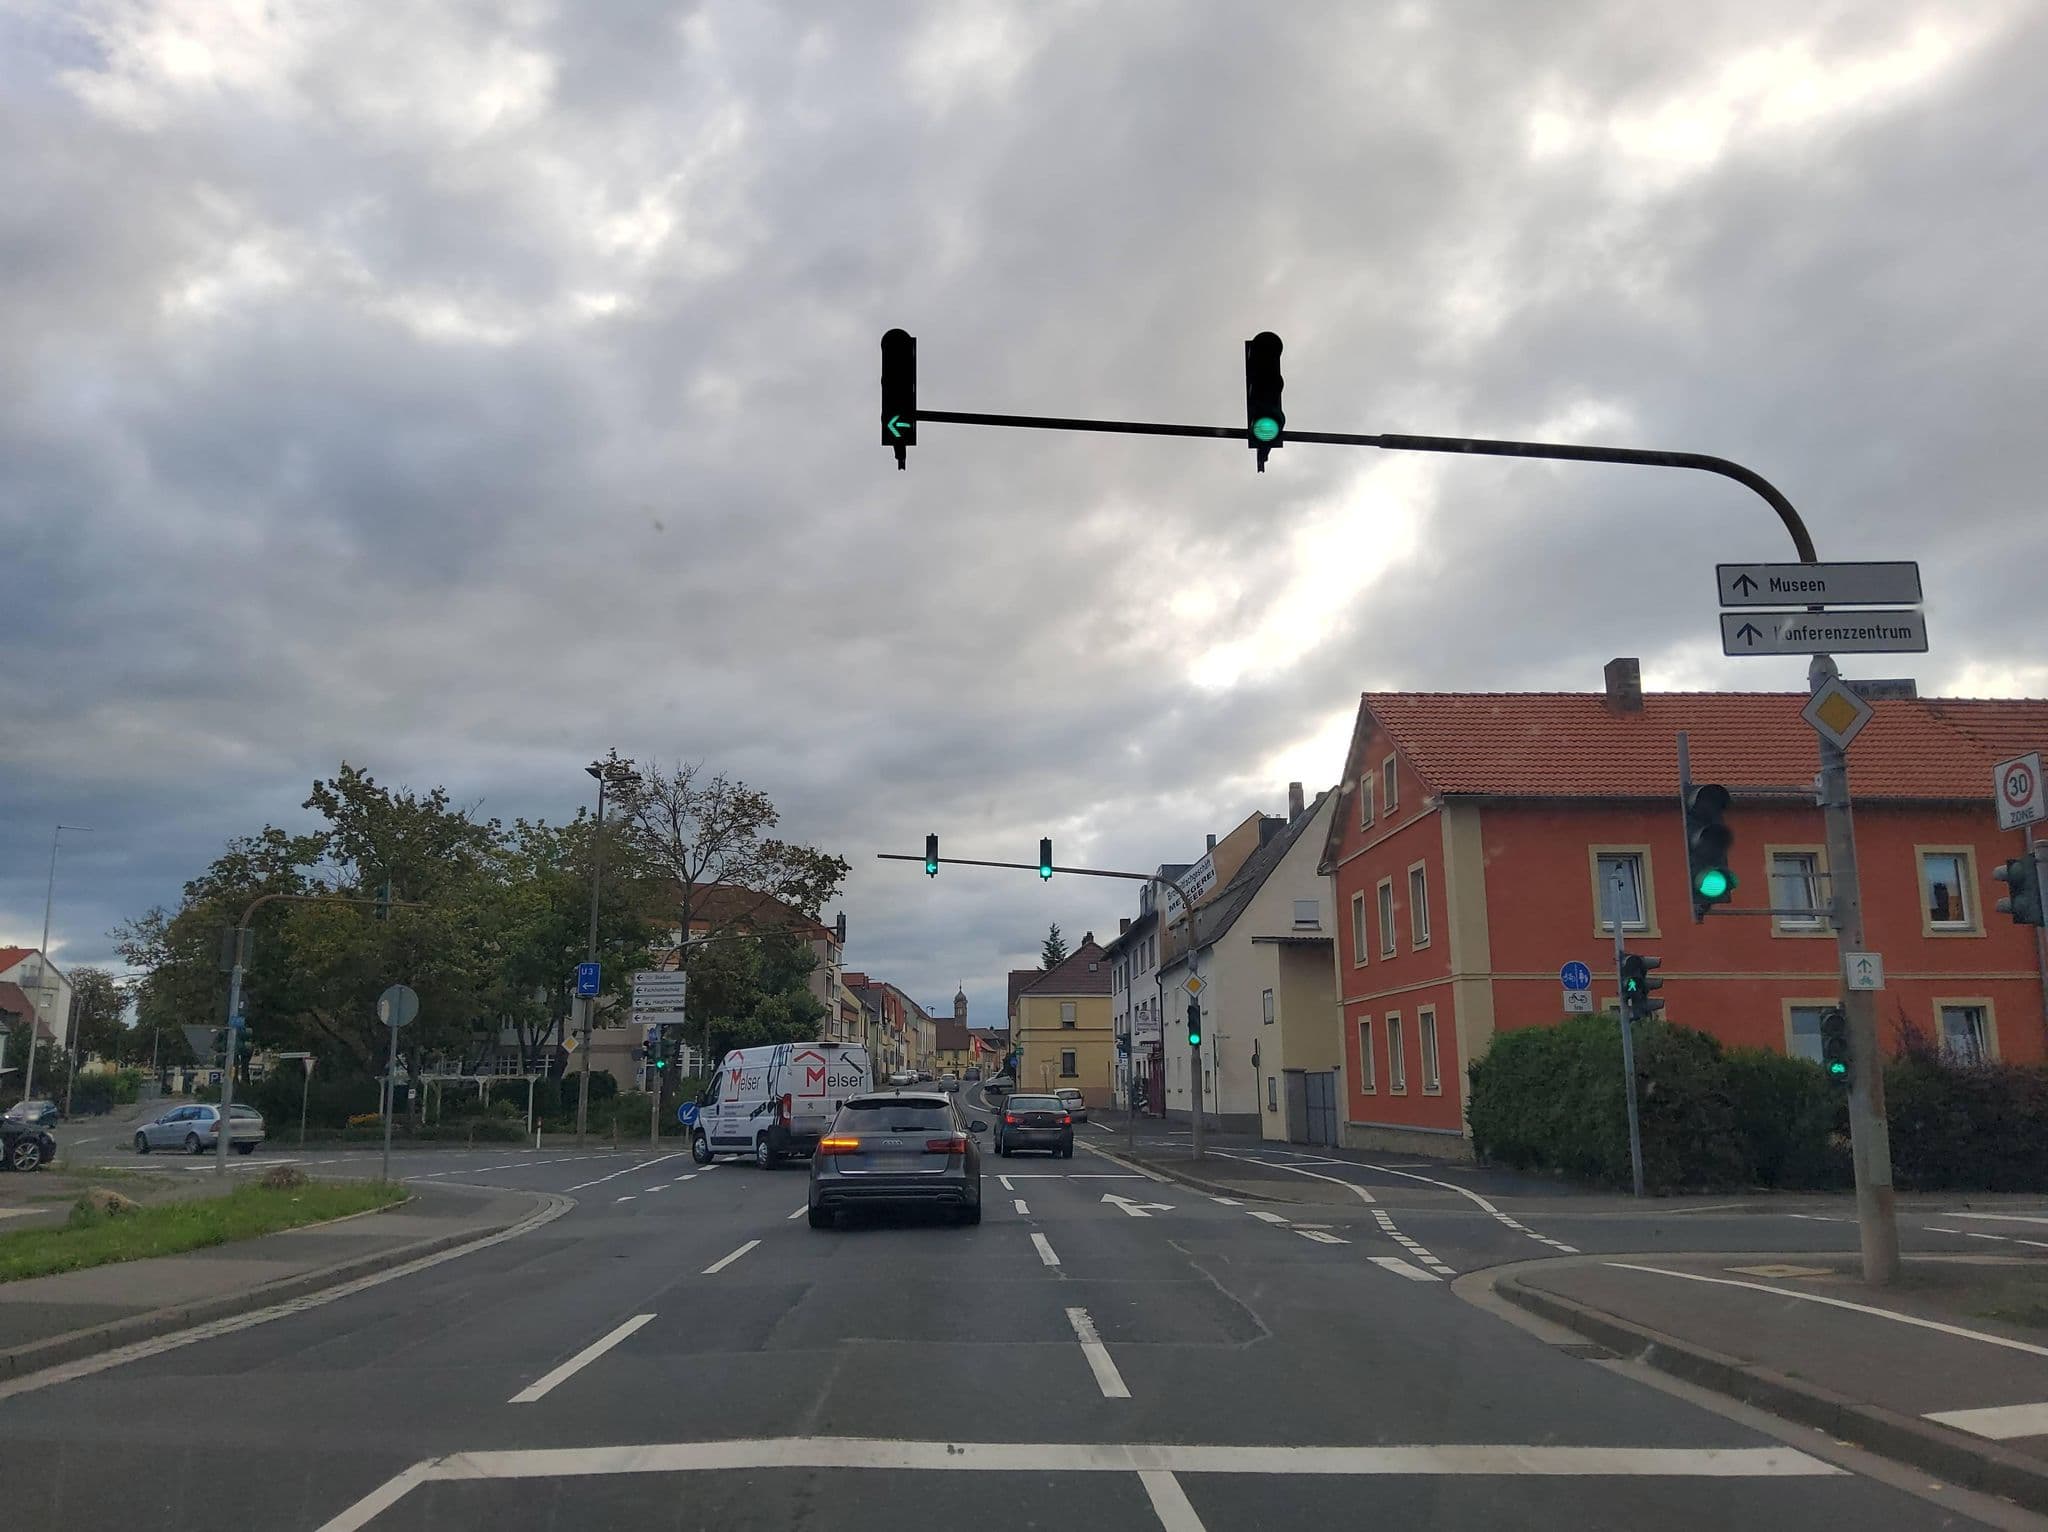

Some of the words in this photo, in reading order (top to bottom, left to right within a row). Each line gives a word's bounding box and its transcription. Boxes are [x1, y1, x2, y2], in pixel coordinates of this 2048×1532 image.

[1769, 576, 1826, 593] Museen
[2008, 773, 2028, 797] 30
[2009, 807, 2035, 824] ZONE
[1168, 869, 1215, 913] MEZGEREI
[806, 1066, 865, 1090] Melser
